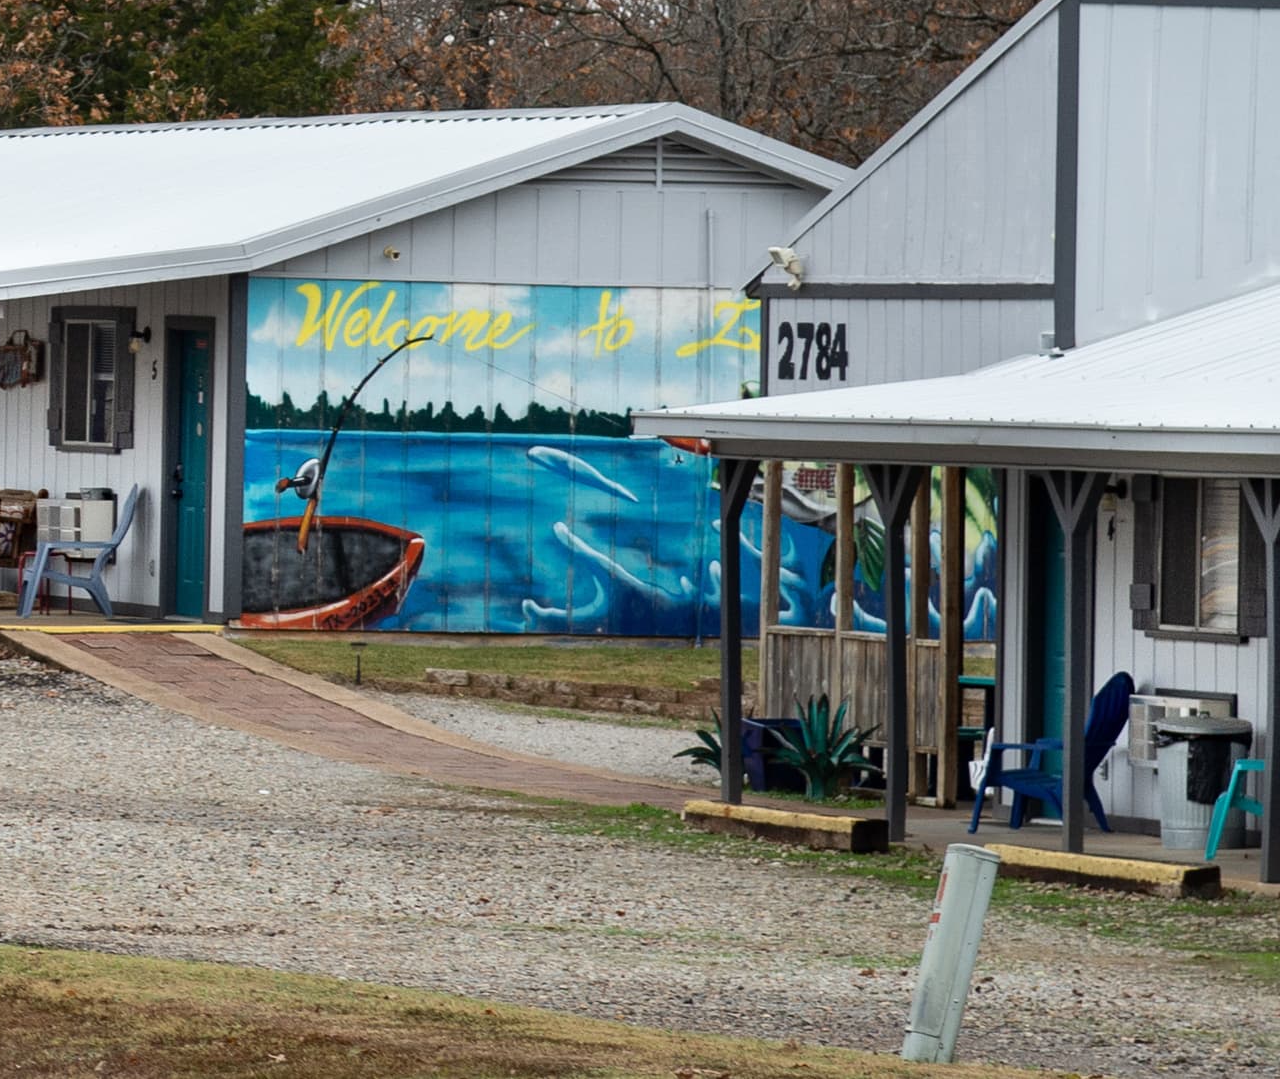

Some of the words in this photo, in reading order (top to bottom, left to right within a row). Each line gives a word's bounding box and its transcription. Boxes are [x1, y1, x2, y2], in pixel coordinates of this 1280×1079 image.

[296, 281, 535, 352] Welcome
[579, 290, 635, 358] to
[777, 321, 849, 381] 2784
